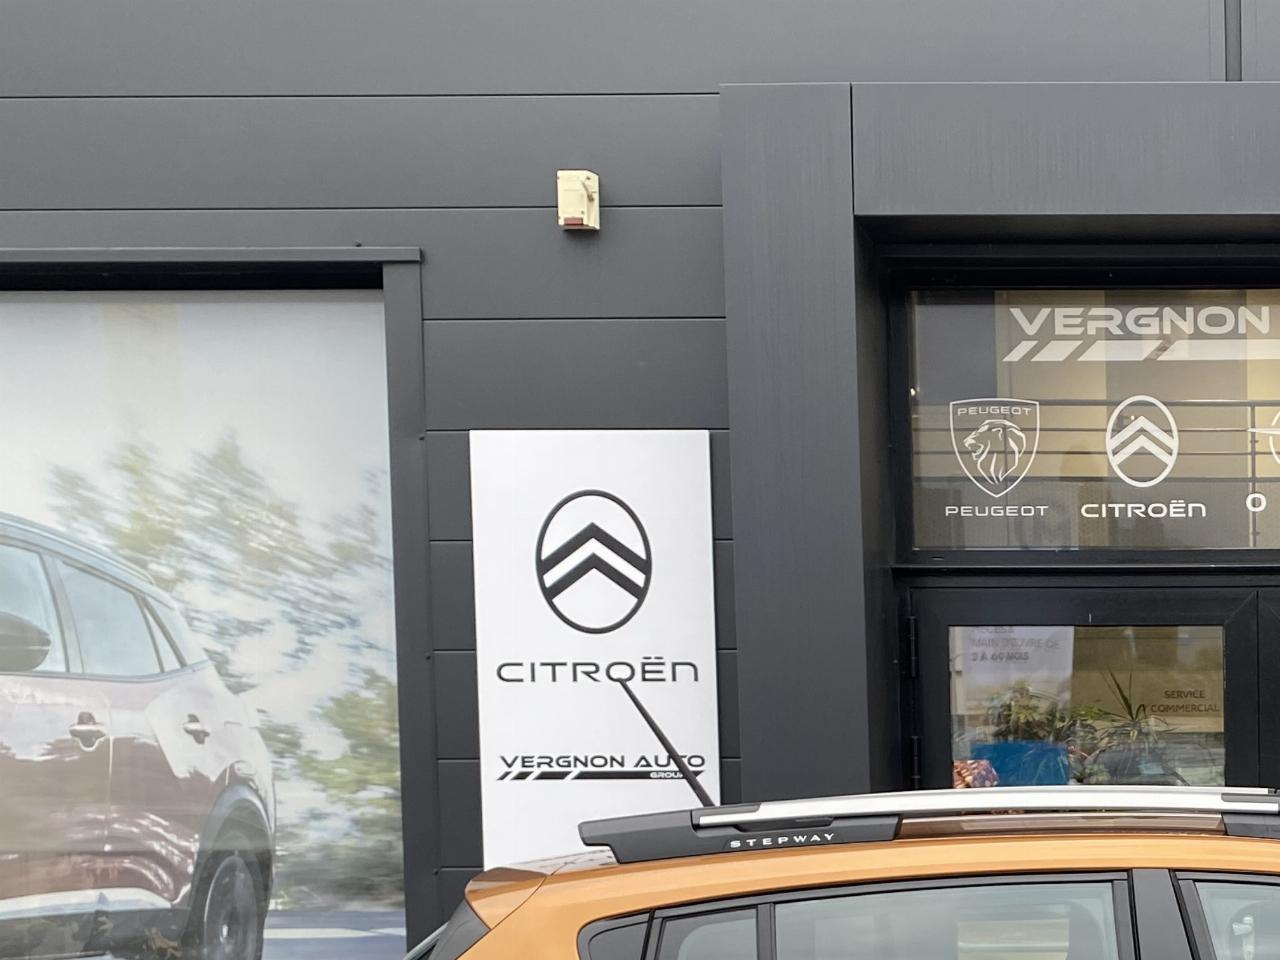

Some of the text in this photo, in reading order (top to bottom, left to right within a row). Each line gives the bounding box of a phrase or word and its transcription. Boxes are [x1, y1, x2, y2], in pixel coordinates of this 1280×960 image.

[1009, 306, 1271, 336] VERGNON
[957, 406, 1032, 417] PEUGEOT
[945, 505, 1049, 518] PEUGEOT
[1081, 500, 1206, 519] CITROËN
[496, 657, 699, 683] CITROËN
[1164, 690, 1206, 699] SERVICE
[1150, 703, 1220, 713] COMMERCIAL
[500, 755, 626, 769] VERGNON
[730, 833, 834, 848] STEPWAY
